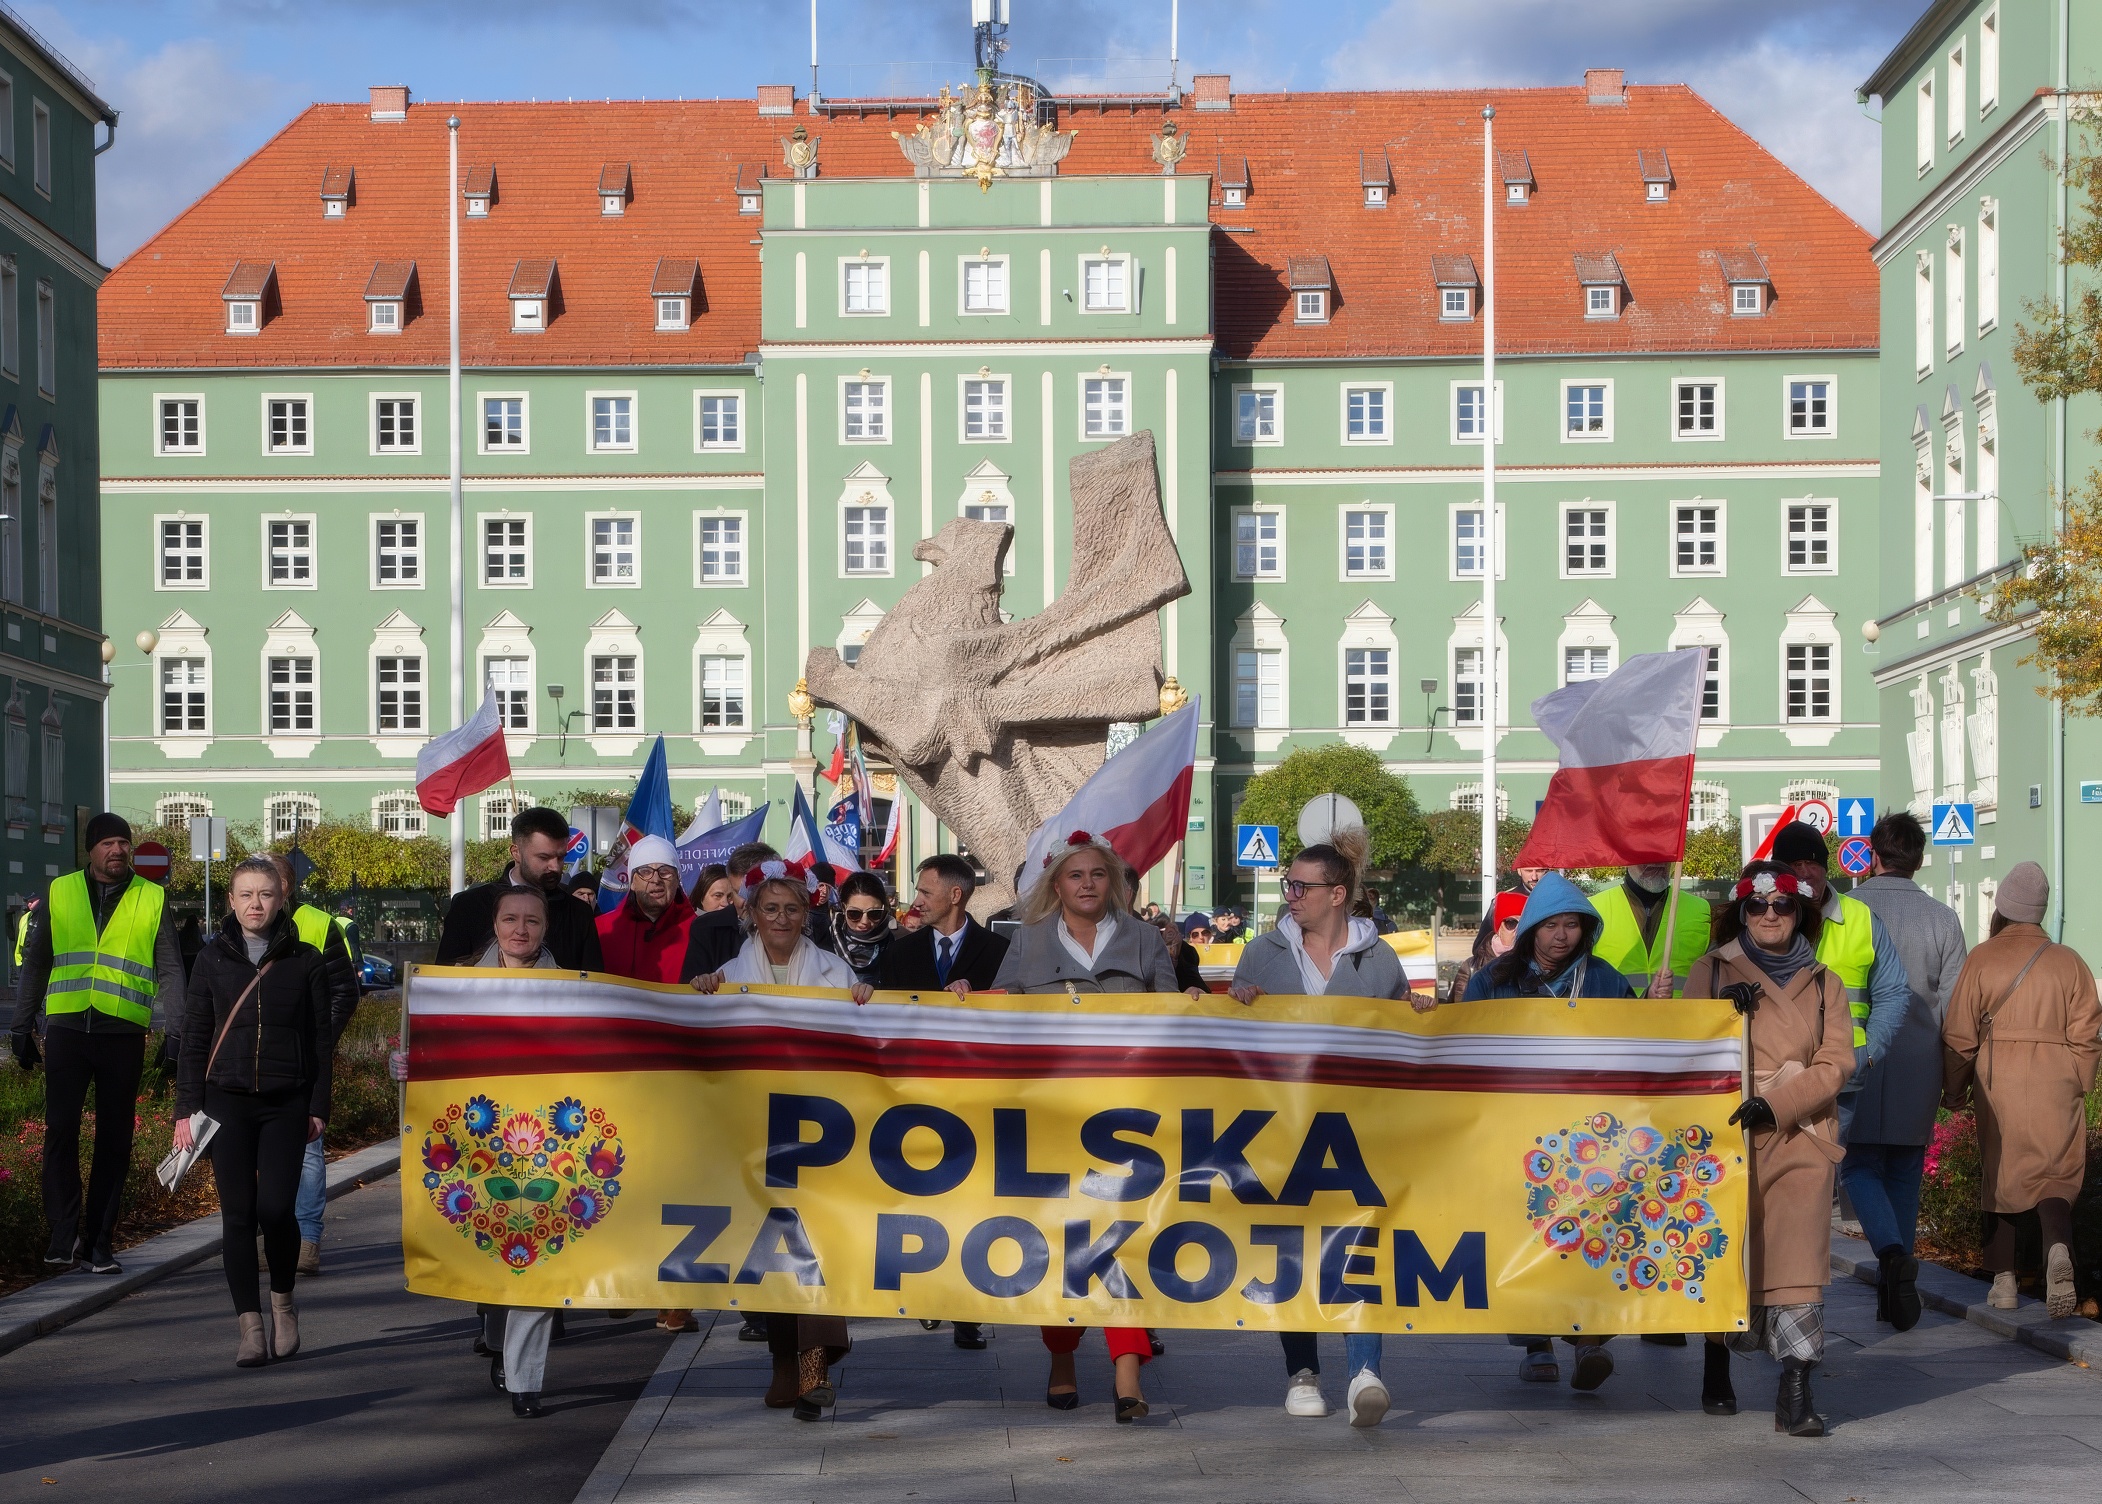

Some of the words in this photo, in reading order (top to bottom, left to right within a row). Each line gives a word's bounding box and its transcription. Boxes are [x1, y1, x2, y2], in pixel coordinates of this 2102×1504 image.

[765, 1093, 1386, 1206] POLSKA
[658, 1204, 825, 1286] ZA
[874, 1214, 1488, 1309] POKOJEM
